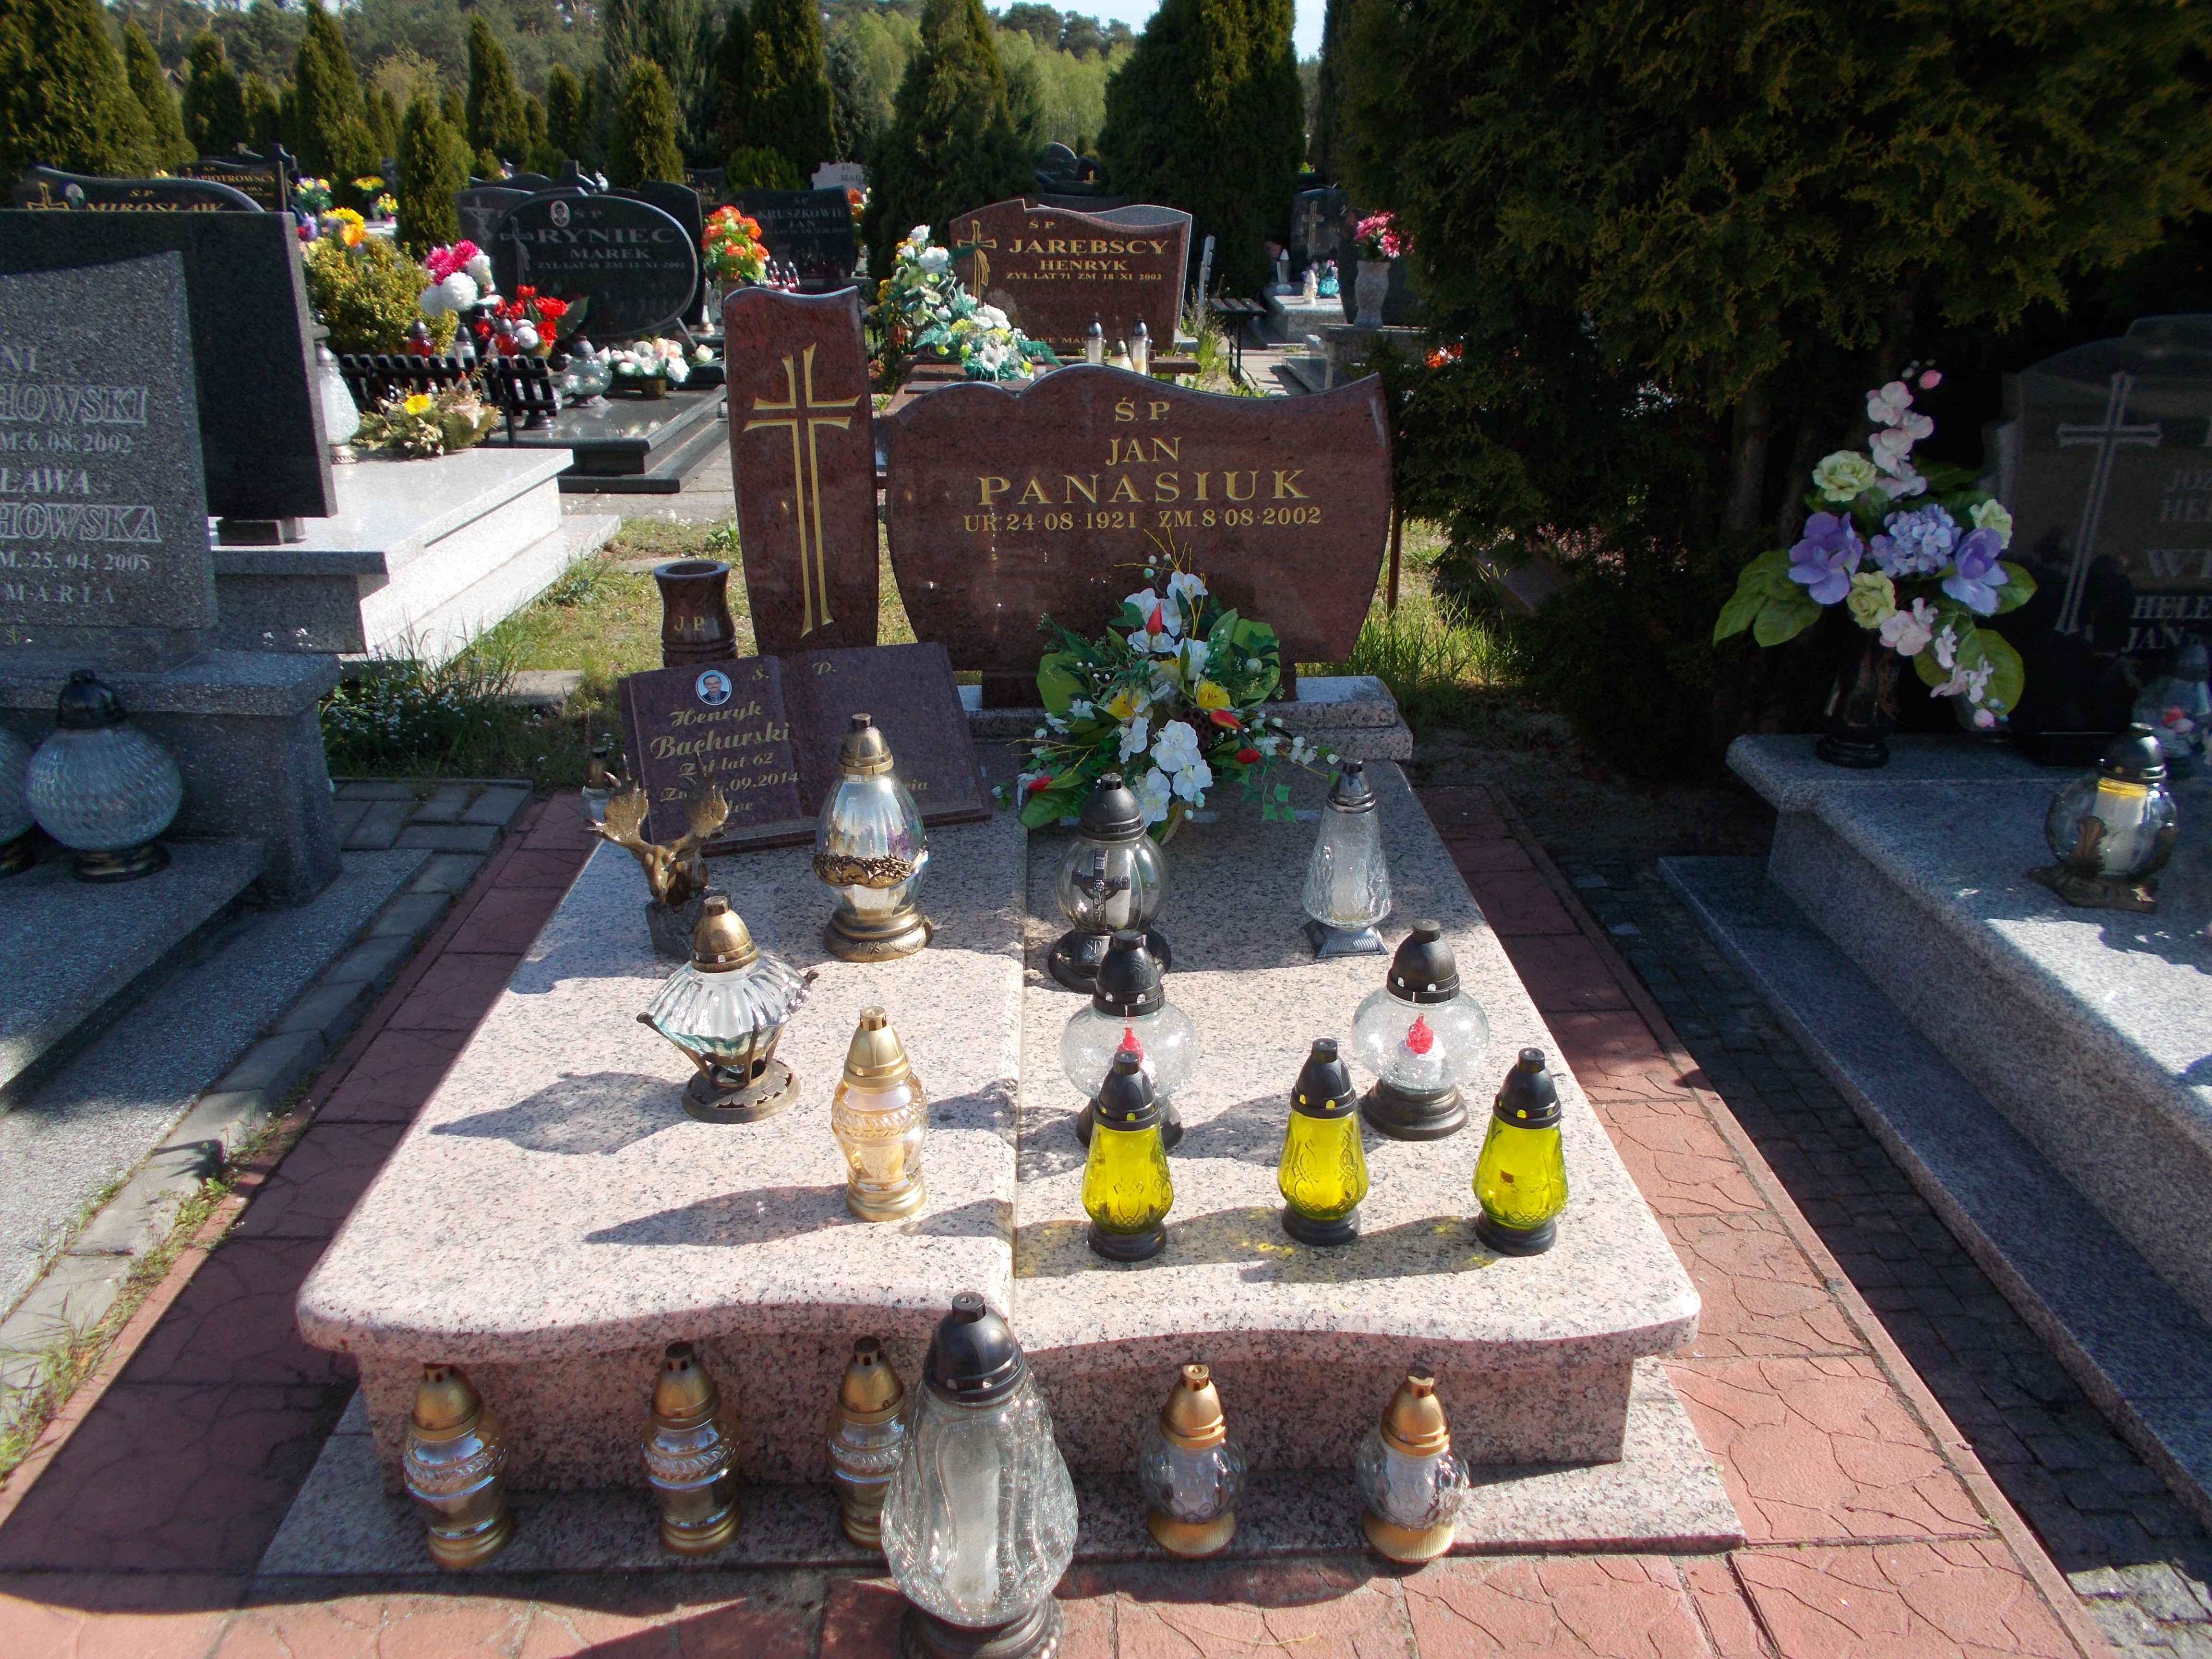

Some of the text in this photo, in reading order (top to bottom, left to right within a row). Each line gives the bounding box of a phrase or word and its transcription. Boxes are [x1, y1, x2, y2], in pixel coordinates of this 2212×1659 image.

[538, 228, 674, 242] RYNIEC
[570, 248, 650, 259] MAREK
[1008, 239, 1168, 256] JARĘBSCY
[1039, 260, 1129, 270] HENRYK
[1105, 436, 1181, 466] JAN
[976, 469, 1310, 506] PANASIUK
[103, 553, 150, 571] 2005
[669, 700, 762, 727] Henryk
[649, 721, 791, 760] Bachurski
[721, 756, 745, 771] lat
[752, 752, 774, 766] 62
